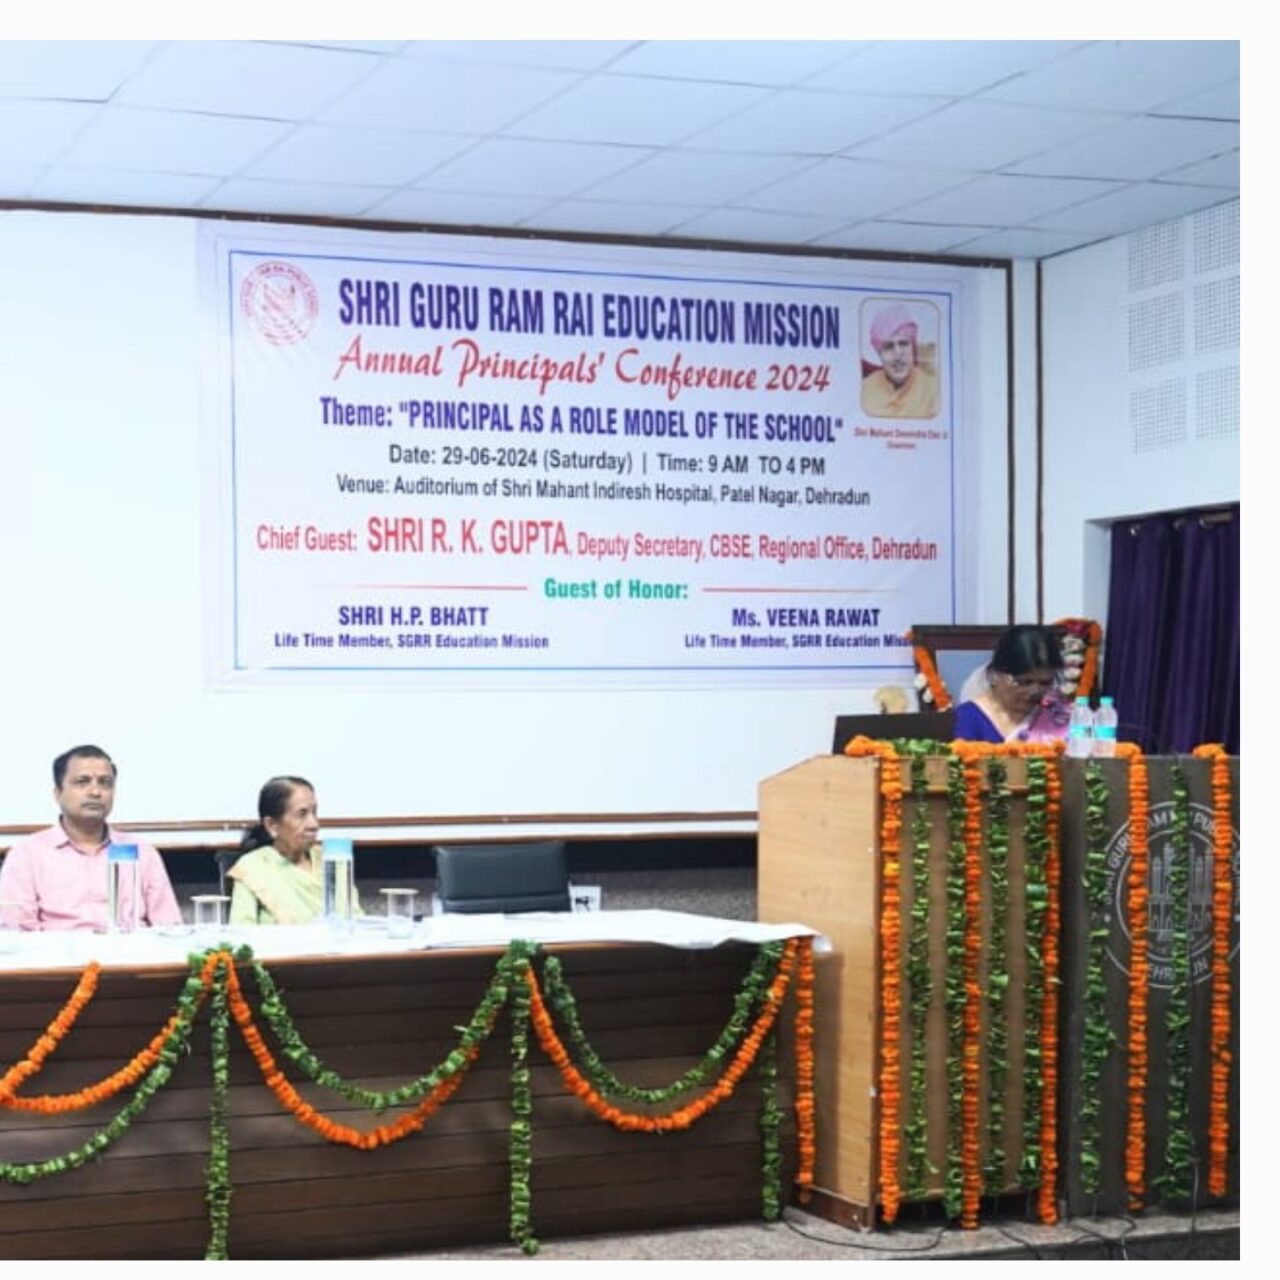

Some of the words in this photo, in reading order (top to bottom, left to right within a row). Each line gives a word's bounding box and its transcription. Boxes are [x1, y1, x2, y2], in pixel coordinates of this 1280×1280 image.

[340, 279, 399, 326] SHRI
[410, 282, 478, 331] GURU
[489, 288, 543, 333] RAM
[554, 291, 593, 336] RAI
[603, 294, 735, 343] EDUCATION
[744, 302, 839, 348] MISSION
[334, 334, 443, 379] Annual
[452, 338, 605, 395] Principals'
[615, 348, 756, 400] Conference
[765, 364, 829, 392] 2024
[320, 397, 392, 427] Theme:
[400, 400, 513, 431] "PRINCIPAL
[520, 405, 544, 433] AS
[551, 406, 563, 433] A
[570, 407, 617, 435] ROLE
[624, 409, 688, 437] MODEL
[695, 411, 717, 438] OF
[724, 412, 758, 439] THE
[765, 414, 842, 442] SCHOOL"
[389, 444, 435, 464] Date:
[443, 446, 537, 467] 29-06-2024
[544, 449, 632, 474] (Saturday)
[657, 453, 702, 472] Time:
[708, 455, 717, 473] 9
[722, 455, 748, 473] AM
[758, 456, 781, 474] TO
[786, 457, 795, 474] 4
[800, 457, 825, 475] PM
[337, 474, 388, 493] Venue:
[394, 476, 478, 495] Auditorium
[483, 478, 497, 496] of
[502, 479, 531, 497] Shri
[536, 480, 589, 498] Mahant
[593, 482, 651, 500] Indiresh
[721, 485, 754, 502] Patel
[806, 487, 870, 505] Dehradun
[257, 524, 300, 550] Chief
[304, 526, 356, 551] Guest:
[368, 516, 423, 552] SHRI
[578, 532, 629, 562] Deputy
[759, 535, 820, 564] Regional
[872, 537, 937, 560] Dehradun
[544, 578, 597, 598] Guest
[604, 579, 621, 599] of
[629, 579, 688, 599] Honor:
[339, 606, 383, 625] SHRI
[391, 607, 423, 625] H.P.
[431, 607, 488, 626] BHATT
[732, 608, 760, 627] Ms.
[767, 609, 819, 627] VEENA
[825, 609, 880, 626] RAWAT
[275, 633, 298, 647] Life
[303, 633, 334, 647] Time
[398, 634, 431, 648] SGRR
[436, 634, 498, 648] Education
[502, 634, 549, 648] Mission
[685, 635, 706, 648] Life
[710, 634, 737, 647] Time
[792, 634, 822, 647] SGRR
[825, 634, 880, 647] Education
